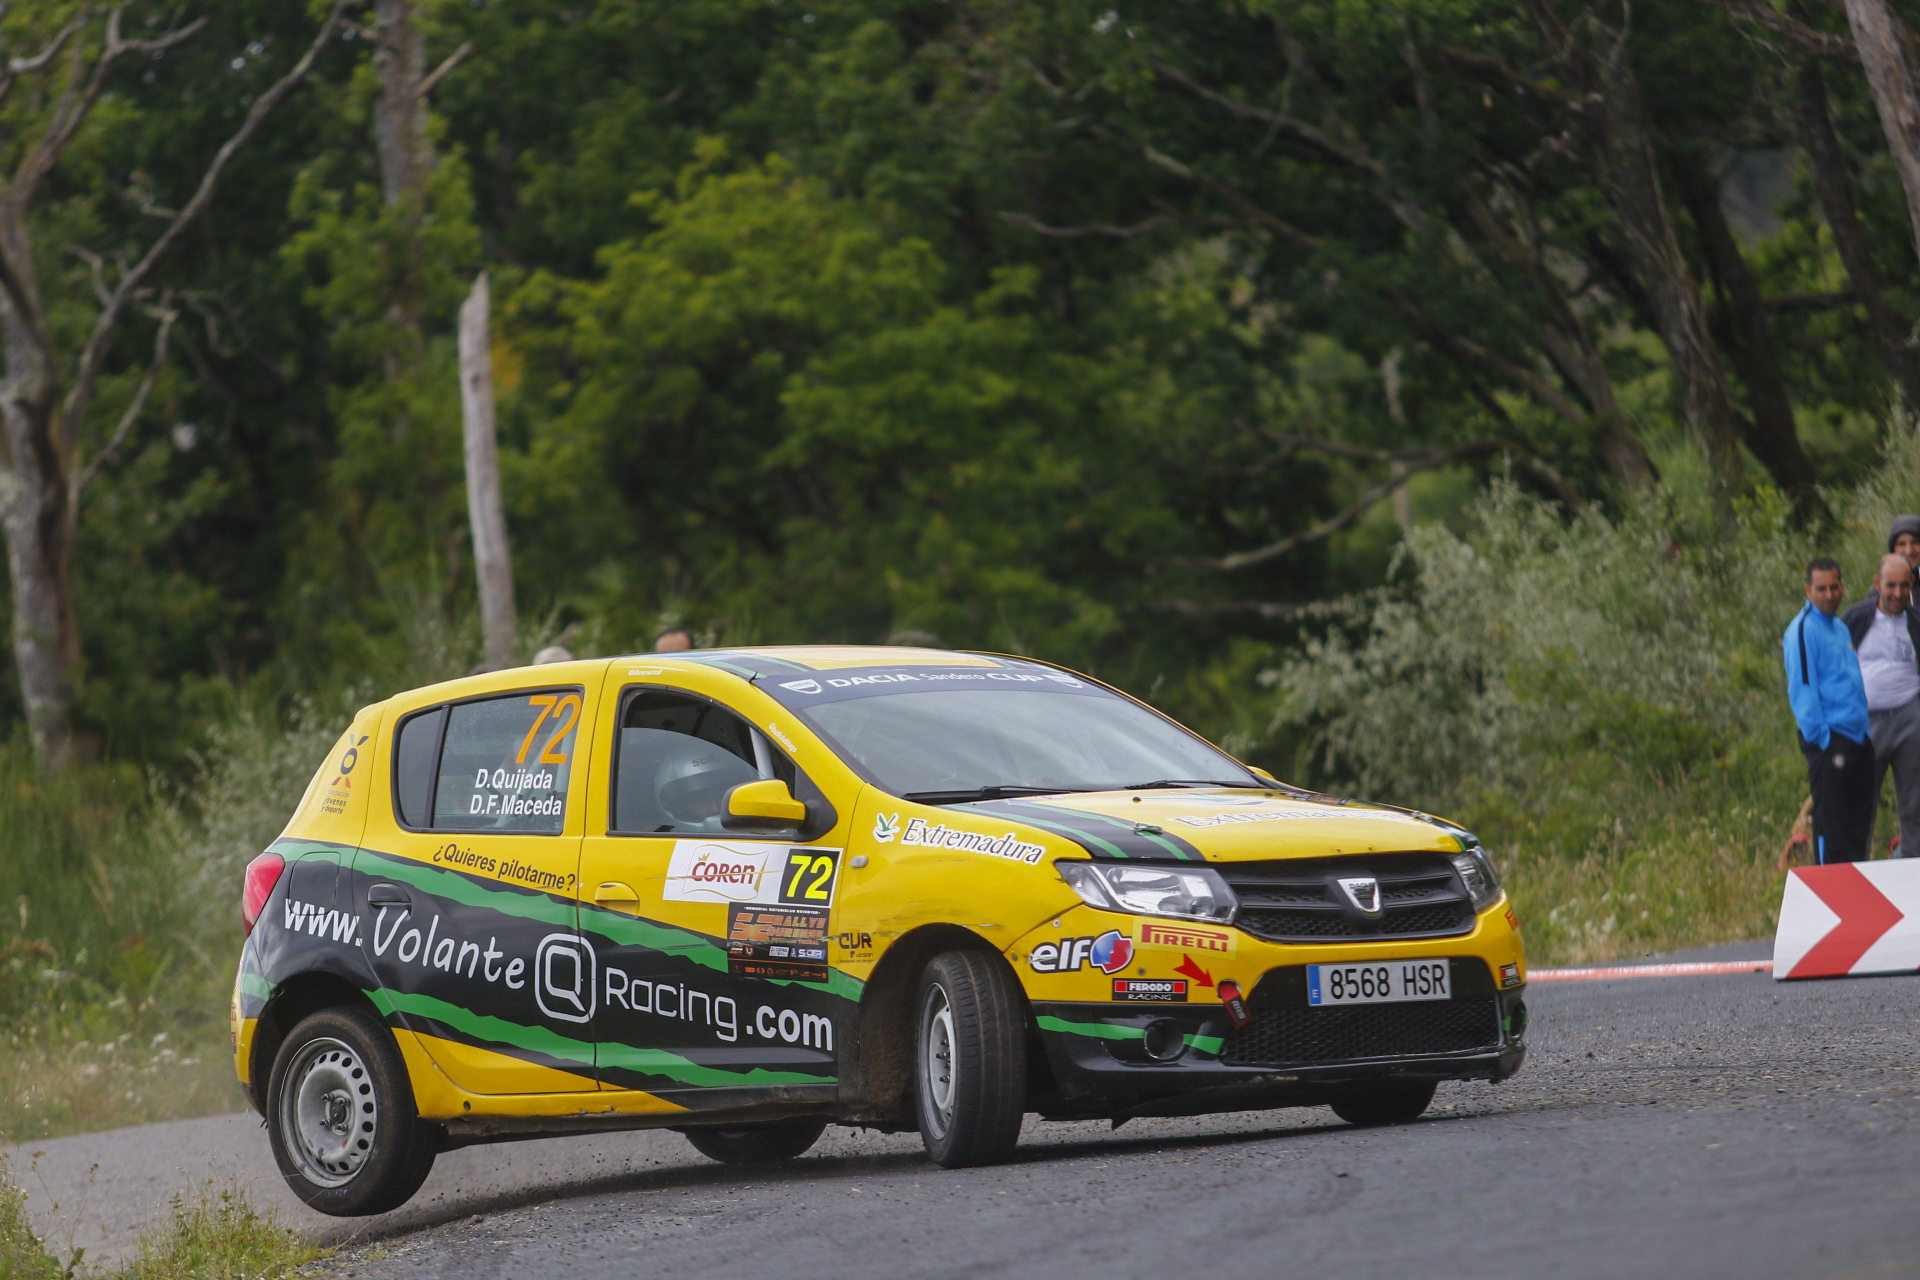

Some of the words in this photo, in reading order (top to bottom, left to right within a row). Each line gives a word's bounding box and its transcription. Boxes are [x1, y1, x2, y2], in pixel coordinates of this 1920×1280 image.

[826, 673, 921, 688] DACIA
[920, 672, 986, 681] Sandero
[986, 672, 1044, 682] CUP
[515, 694, 582, 764] 72
[475, 768, 553, 794] D.Quijada
[470, 794, 562, 815] D.F.Maceda
[902, 818, 1043, 864] Extremadura
[433, 843, 496, 872] ¿Quieres
[497, 859, 576, 891] pilotarme?
[786, 855, 833, 899] 72
[1141, 924, 1229, 953] PIRELLI
[1030, 938, 1091, 971] elf
[285, 898, 363, 947] www.
[373, 906, 525, 990] Volante
[606, 967, 738, 1042] Racing
[746, 1005, 833, 1051] .com
[1128, 982, 1172, 992] FERODO
[1330, 967, 1391, 999] 8568
[1403, 964, 1446, 996] HSR
[1128, 993, 1172, 1001] RACING
[1312, 989, 1319, 998] E
